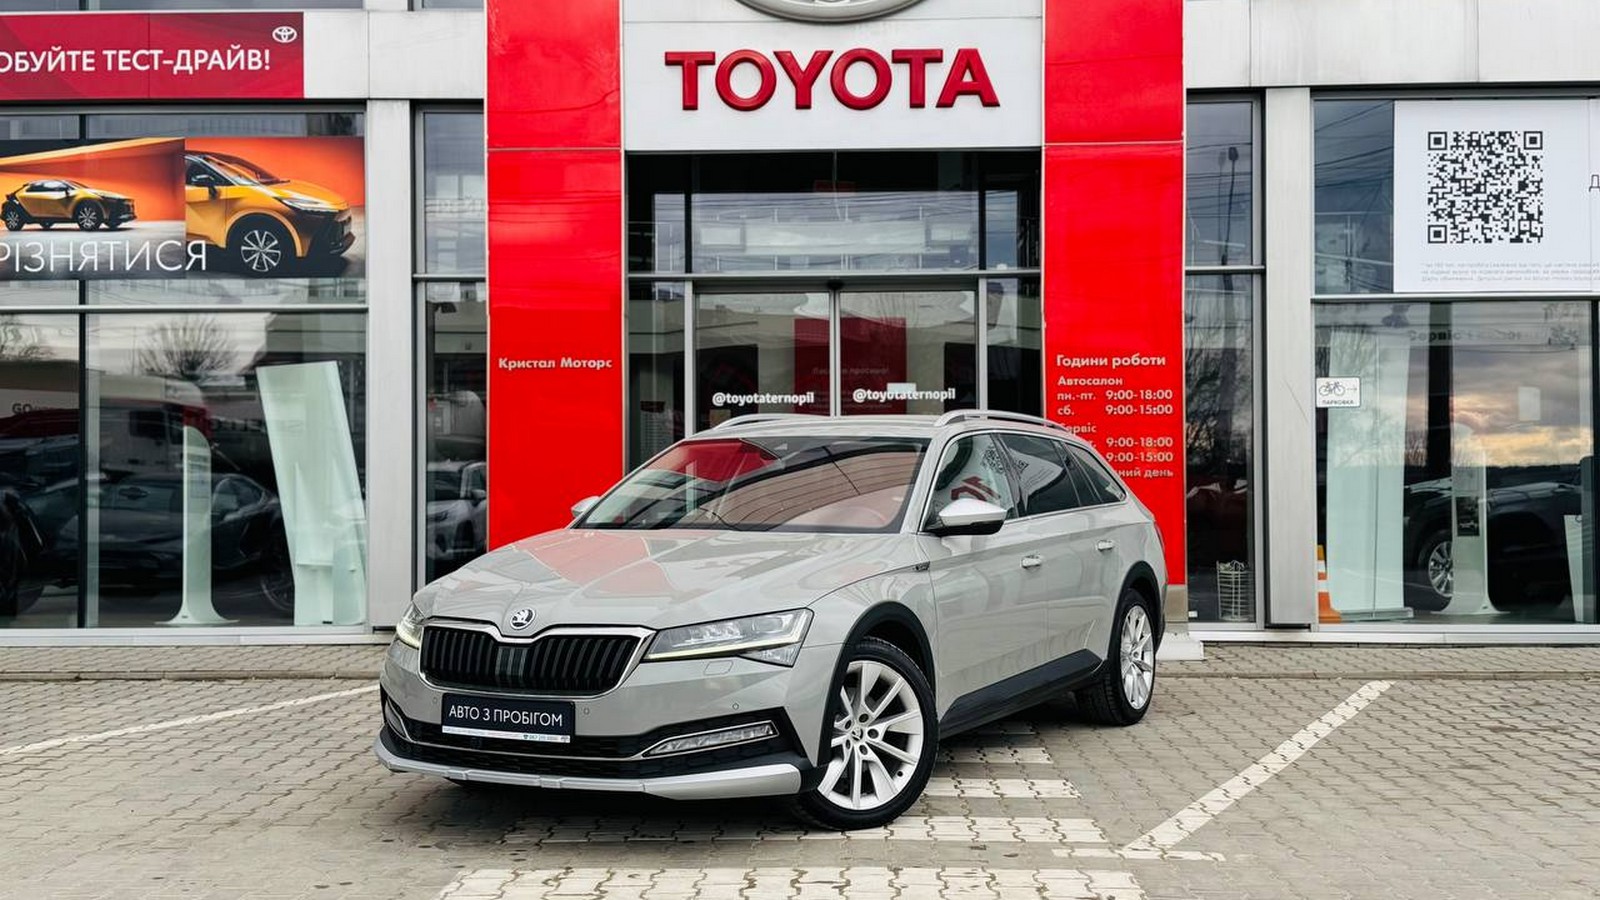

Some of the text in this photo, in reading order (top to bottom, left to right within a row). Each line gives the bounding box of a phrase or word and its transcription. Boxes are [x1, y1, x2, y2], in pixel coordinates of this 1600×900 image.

[103, 44, 271, 75] ТЕСТ-ДРАЙВ!
[664, 47, 1000, 111] TOYOTA
[498, 356, 613, 370] Кристал Моторс
[1056, 353, 1166, 369] Години роботи
[1057, 376, 1123, 386] Автосалон
[711, 390, 815, 407] @toyotaternopil
[852, 387, 956, 402] @toyotaternopil
[1057, 389, 1173, 401] пн.-пт. 9:00-18:00
[1057, 404, 1173, 416] сб. 9:00-15:00
[1106, 437, 1174, 448] 9:00-18:00
[1106, 452, 1174, 463] 9:00-15:00
[1143, 469, 1174, 478] день
[448, 704, 480, 720] АВТО
[493, 709, 563, 727] ПРОБІГОМ
